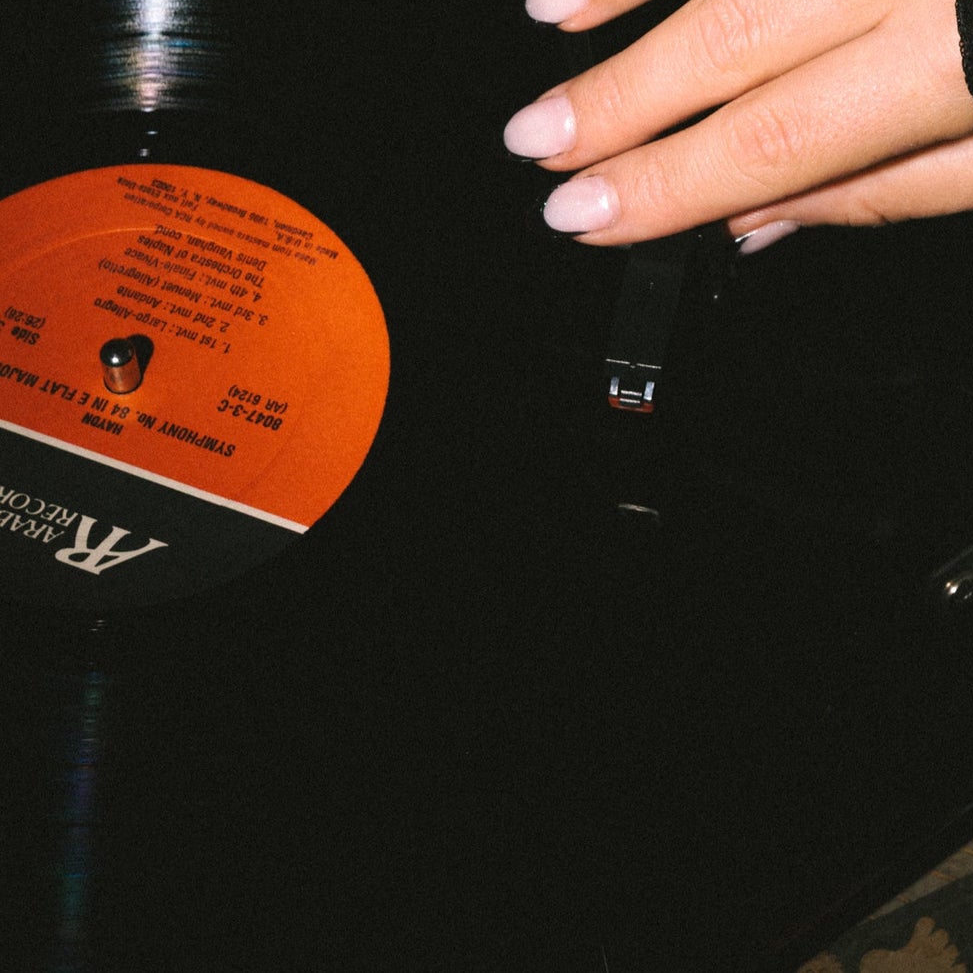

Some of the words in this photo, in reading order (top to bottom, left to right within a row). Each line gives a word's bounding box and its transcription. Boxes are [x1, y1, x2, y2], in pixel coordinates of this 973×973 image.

[136, 234, 175, 257] Naples
[174, 249, 189, 260] of
[123, 247, 198, 281] Finale-Vivace
[189, 253, 243, 280] Orchestra
[235, 252, 268, 272] Denis
[97, 257, 161, 288] (Allegretto)
[244, 272, 265, 289] The
[116, 285, 163, 309] Andante
[160, 280, 203, 304] Menuet
[229, 284, 249, 298] 4th
[252, 291, 262, 303] 4.
[93, 297, 168, 332] Largo-Allegro
[191, 311, 217, 329] 2nd
[232, 305, 255, 322] 3rd
[258, 313, 269, 327] 3.
[10, 325, 41, 346] Side
[219, 320, 231, 334] 2.
[198, 334, 218, 349] 1st
[222, 342, 231, 355] 1.
[0, 360, 40, 388] MAJO
[38, 379, 78, 402] FLAT
[76, 391, 91, 406] E
[227, 384, 262, 406] 6124)
[90, 396, 109, 413] IN
[110, 403, 131, 420] 84
[264, 398, 289, 415] (AR
[80, 411, 124, 436] HAYDN
[136, 411, 158, 430] No.
[216, 398, 283, 431] 8047-3-C
[156, 421, 236, 458] SYMPHONY
